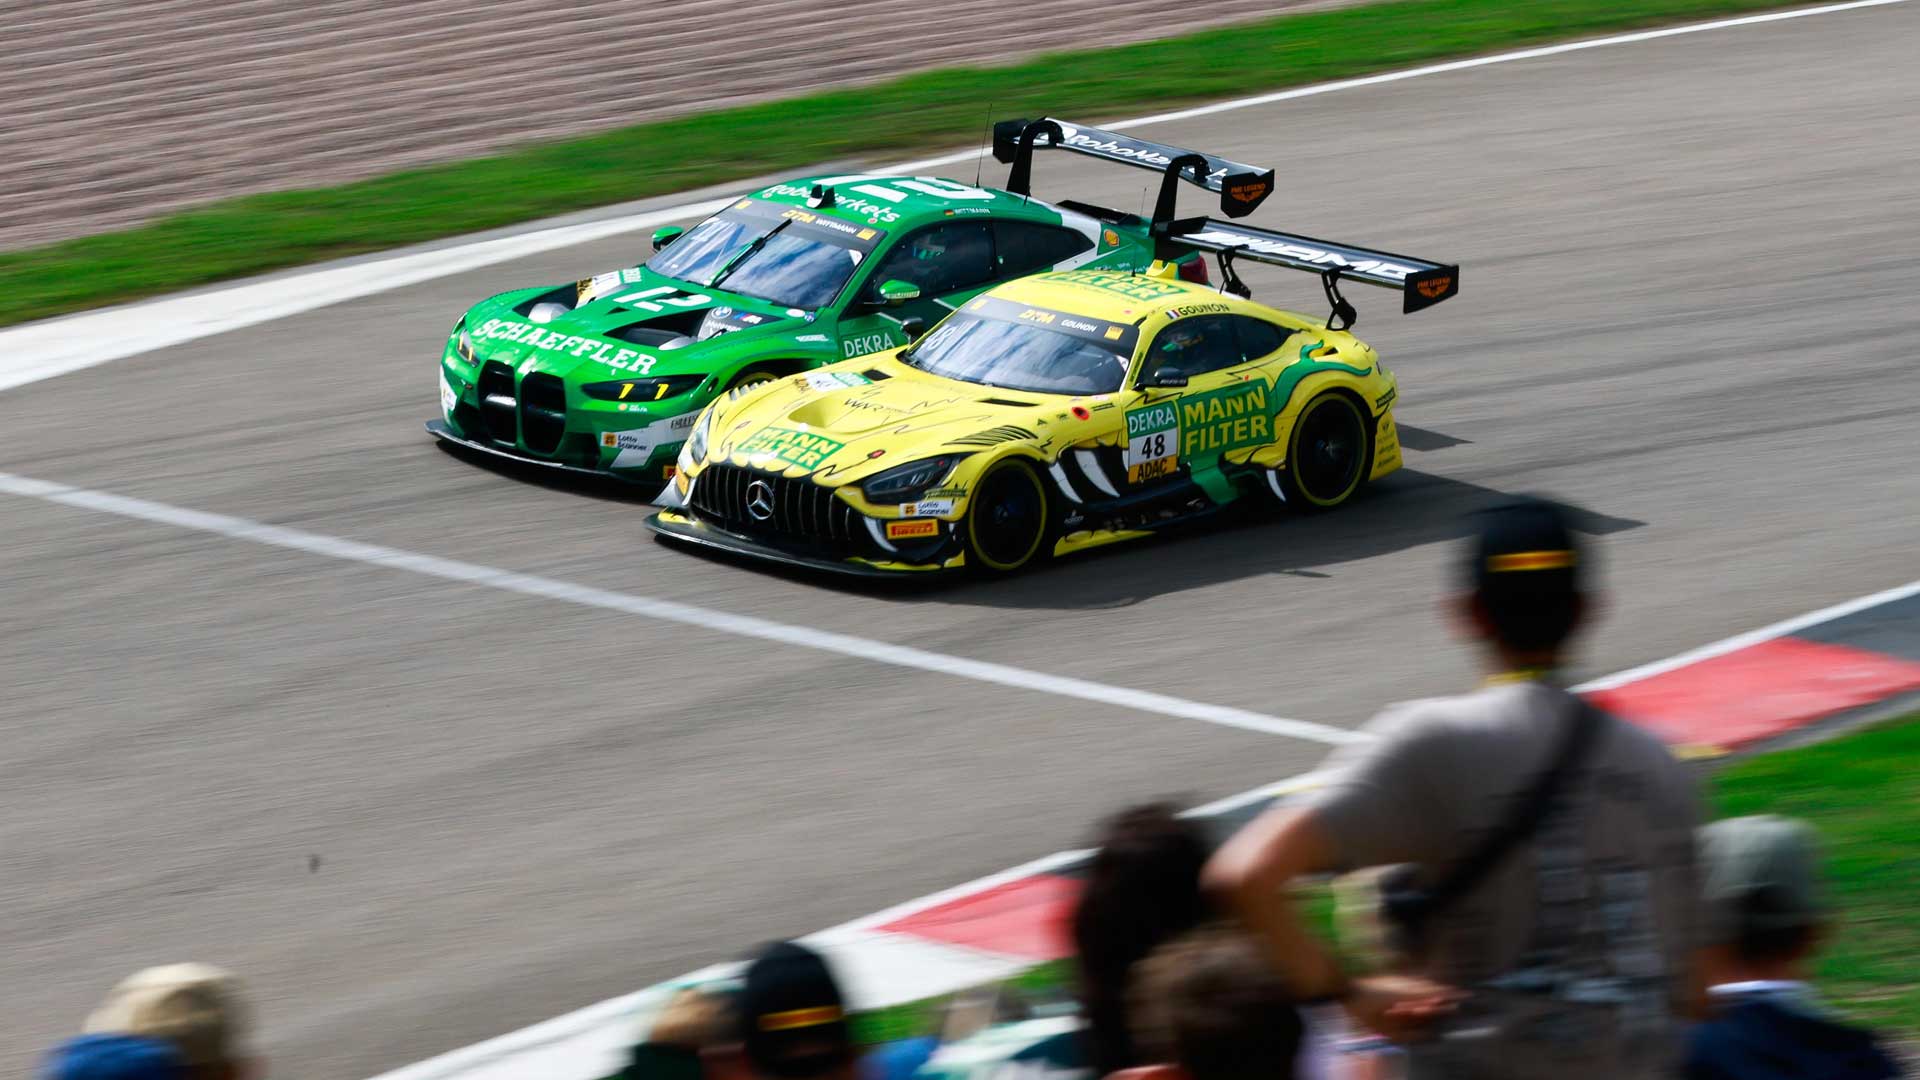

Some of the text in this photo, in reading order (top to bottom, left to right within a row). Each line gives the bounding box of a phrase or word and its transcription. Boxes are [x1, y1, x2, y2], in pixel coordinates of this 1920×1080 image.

[762, 184, 900, 223] Roboarkets
[954, 207, 991, 215] WITTMANN
[816, 217, 858, 234] WITTMANN
[1177, 303, 1230, 317] GOUNON
[1061, 318, 1098, 333] GOUNON
[472, 319, 657, 375] SCHAEFFLER
[843, 333, 896, 358] DEKRA
[1183, 385, 1266, 428] MANN
[1128, 407, 1176, 434] DEKRA
[618, 434, 638, 443] Lotto
[760, 427, 836, 456] MANN
[1141, 434, 1165, 459] 48
[1185, 415, 1268, 456] FILTER
[742, 437, 823, 468] FILTER
[1137, 459, 1167, 482] ADAC
[891, 522, 934, 537] PIRELLI
